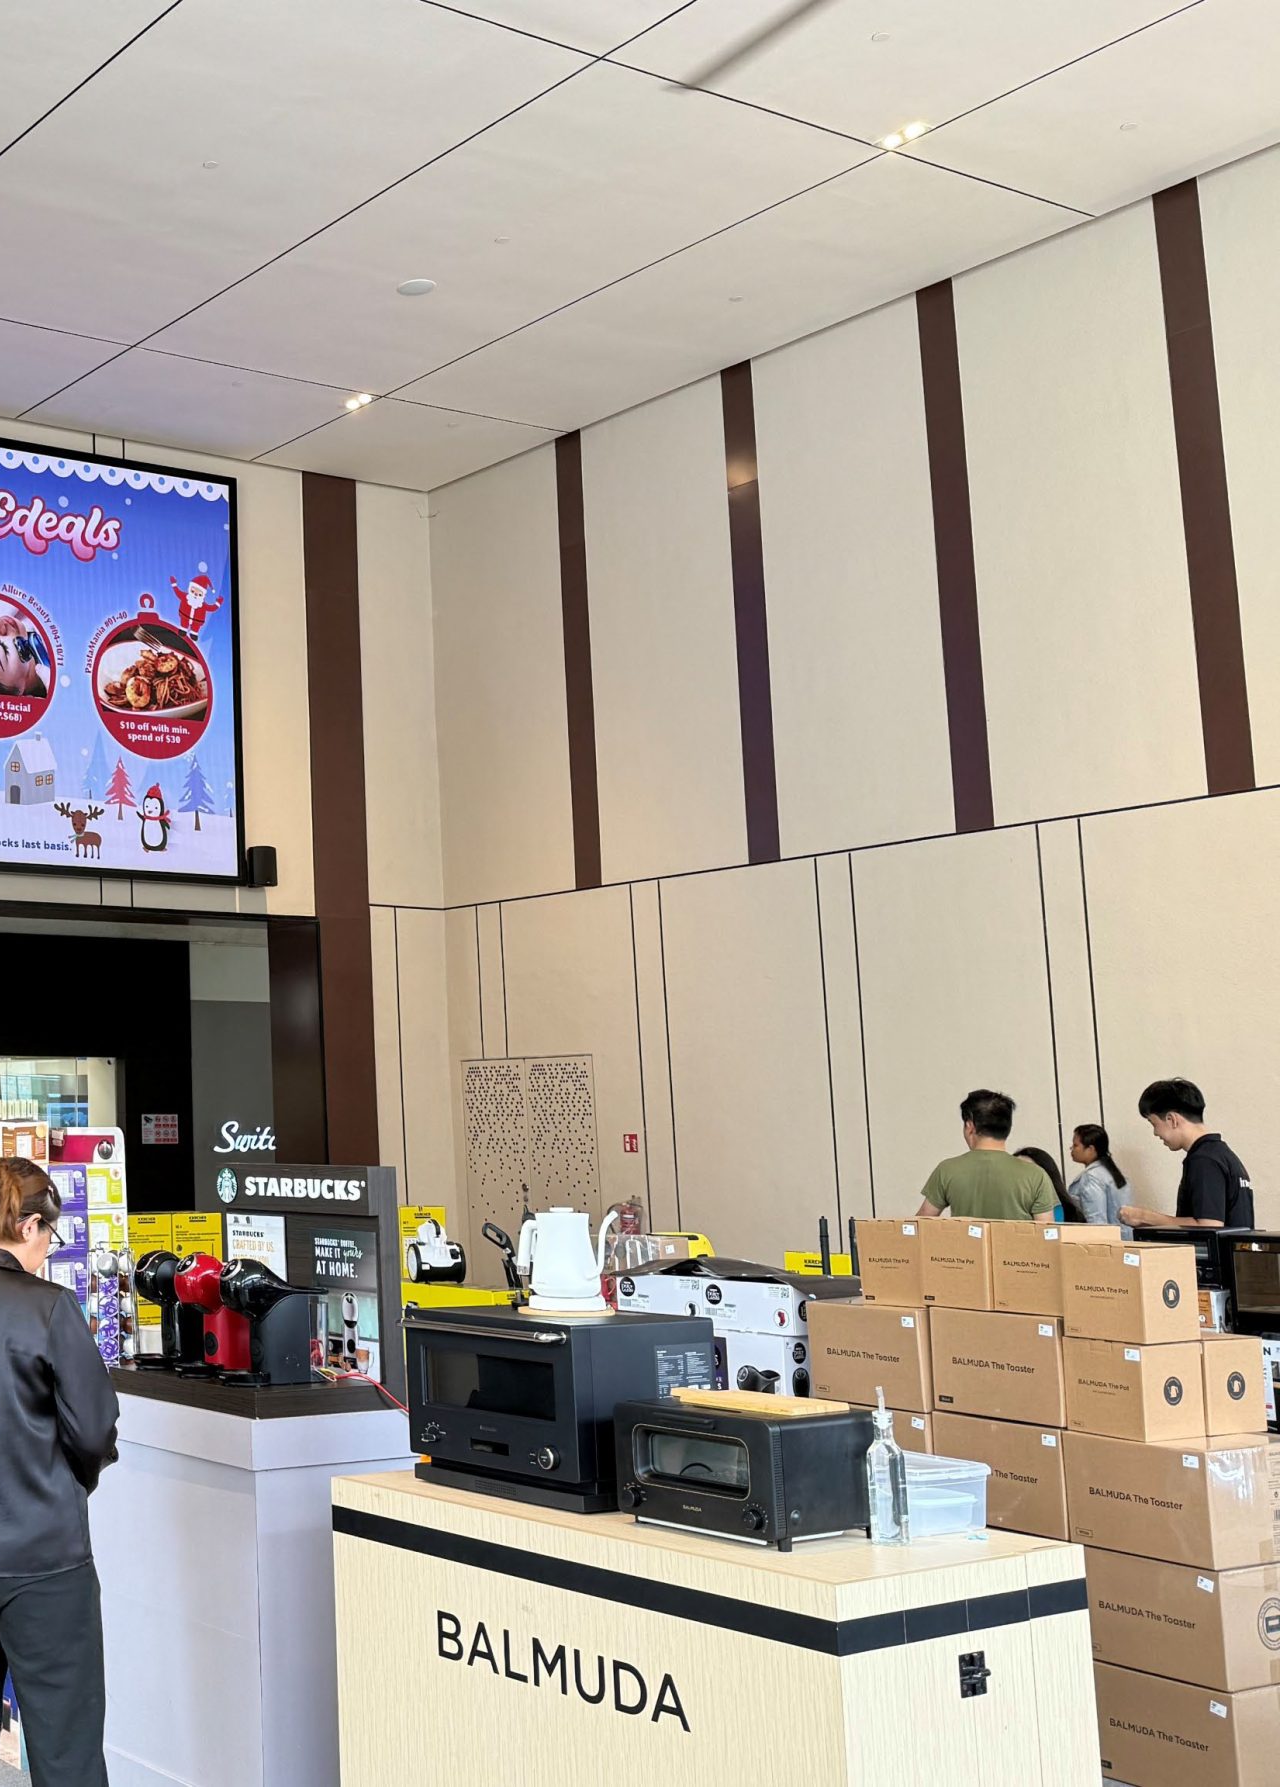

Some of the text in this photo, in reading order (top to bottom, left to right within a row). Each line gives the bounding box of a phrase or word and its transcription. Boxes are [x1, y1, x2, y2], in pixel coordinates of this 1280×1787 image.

[2, 584, 27, 600] Allure
[27, 596, 52, 624] Beauty
[104, 611, 128, 629] #01-40
[7, 700, 31, 712] facial
[119, 720, 190, 735] $10 off with min.
[128, 732, 181, 744] spend of $30
[22, 838, 41, 850] last
[44, 840, 72, 852] basis.
[245, 1176, 363, 1201] STARBUCKS
[315, 1246, 333, 1258] MAKE
[334, 1247, 341, 1259] IT
[316, 1260, 358, 1279] AT HOME.
[1075, 1285, 1106, 1293] BALMUDA
[826, 1347, 900, 1363] BALMUDA The Toaster
[952, 1356, 1035, 1374] BALMUDA The Toaster
[1078, 1378, 1107, 1387] BALMUDA
[1108, 1382, 1119, 1390] The
[994, 1469, 1038, 1484] The Toaster
[1089, 1486, 1183, 1511] BALMUDA The Toaster
[1099, 1600, 1196, 1629] BALMUDA The Toaster
[437, 1610, 691, 1733] BALMUDA
[1109, 1717, 1209, 1752] BALMUDA The Toaster
